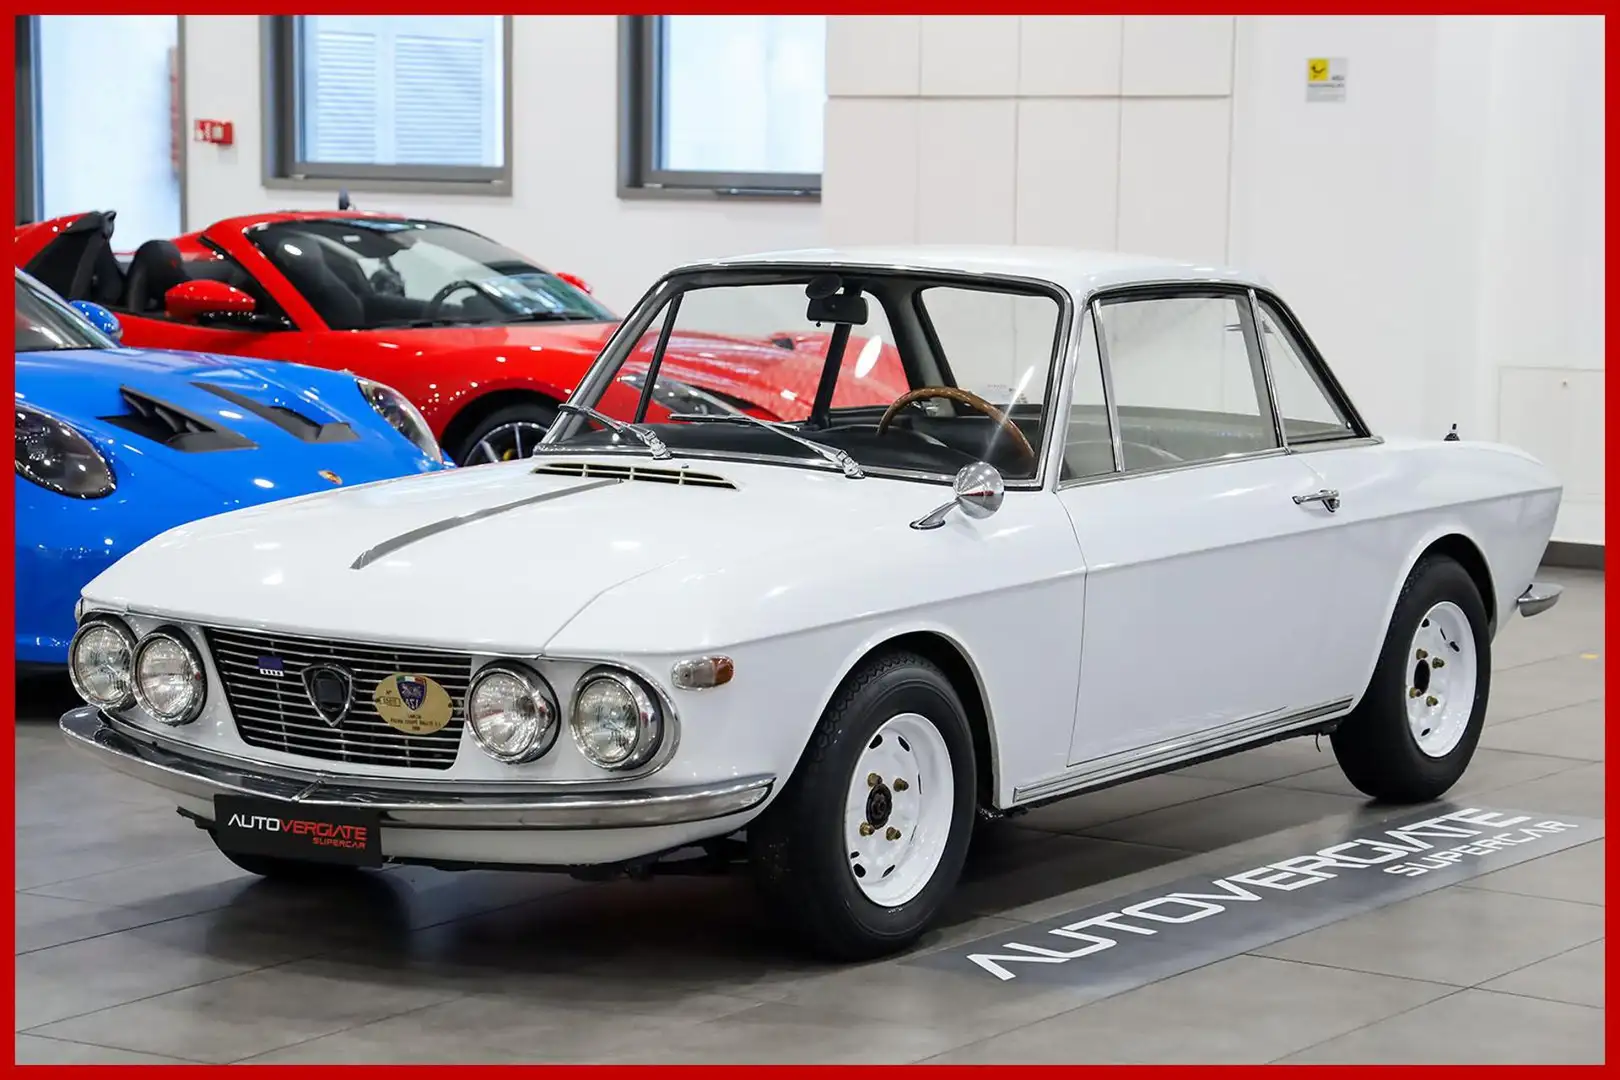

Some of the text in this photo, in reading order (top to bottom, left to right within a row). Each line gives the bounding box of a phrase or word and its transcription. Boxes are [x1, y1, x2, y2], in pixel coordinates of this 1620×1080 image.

[228, 814, 367, 841] AUTOVERGIATE
[312, 837, 366, 849] SUPERCAR
[1382, 820, 1579, 876] SUPERCAR
[966, 808, 1531, 981] AUTOVERGIATE
